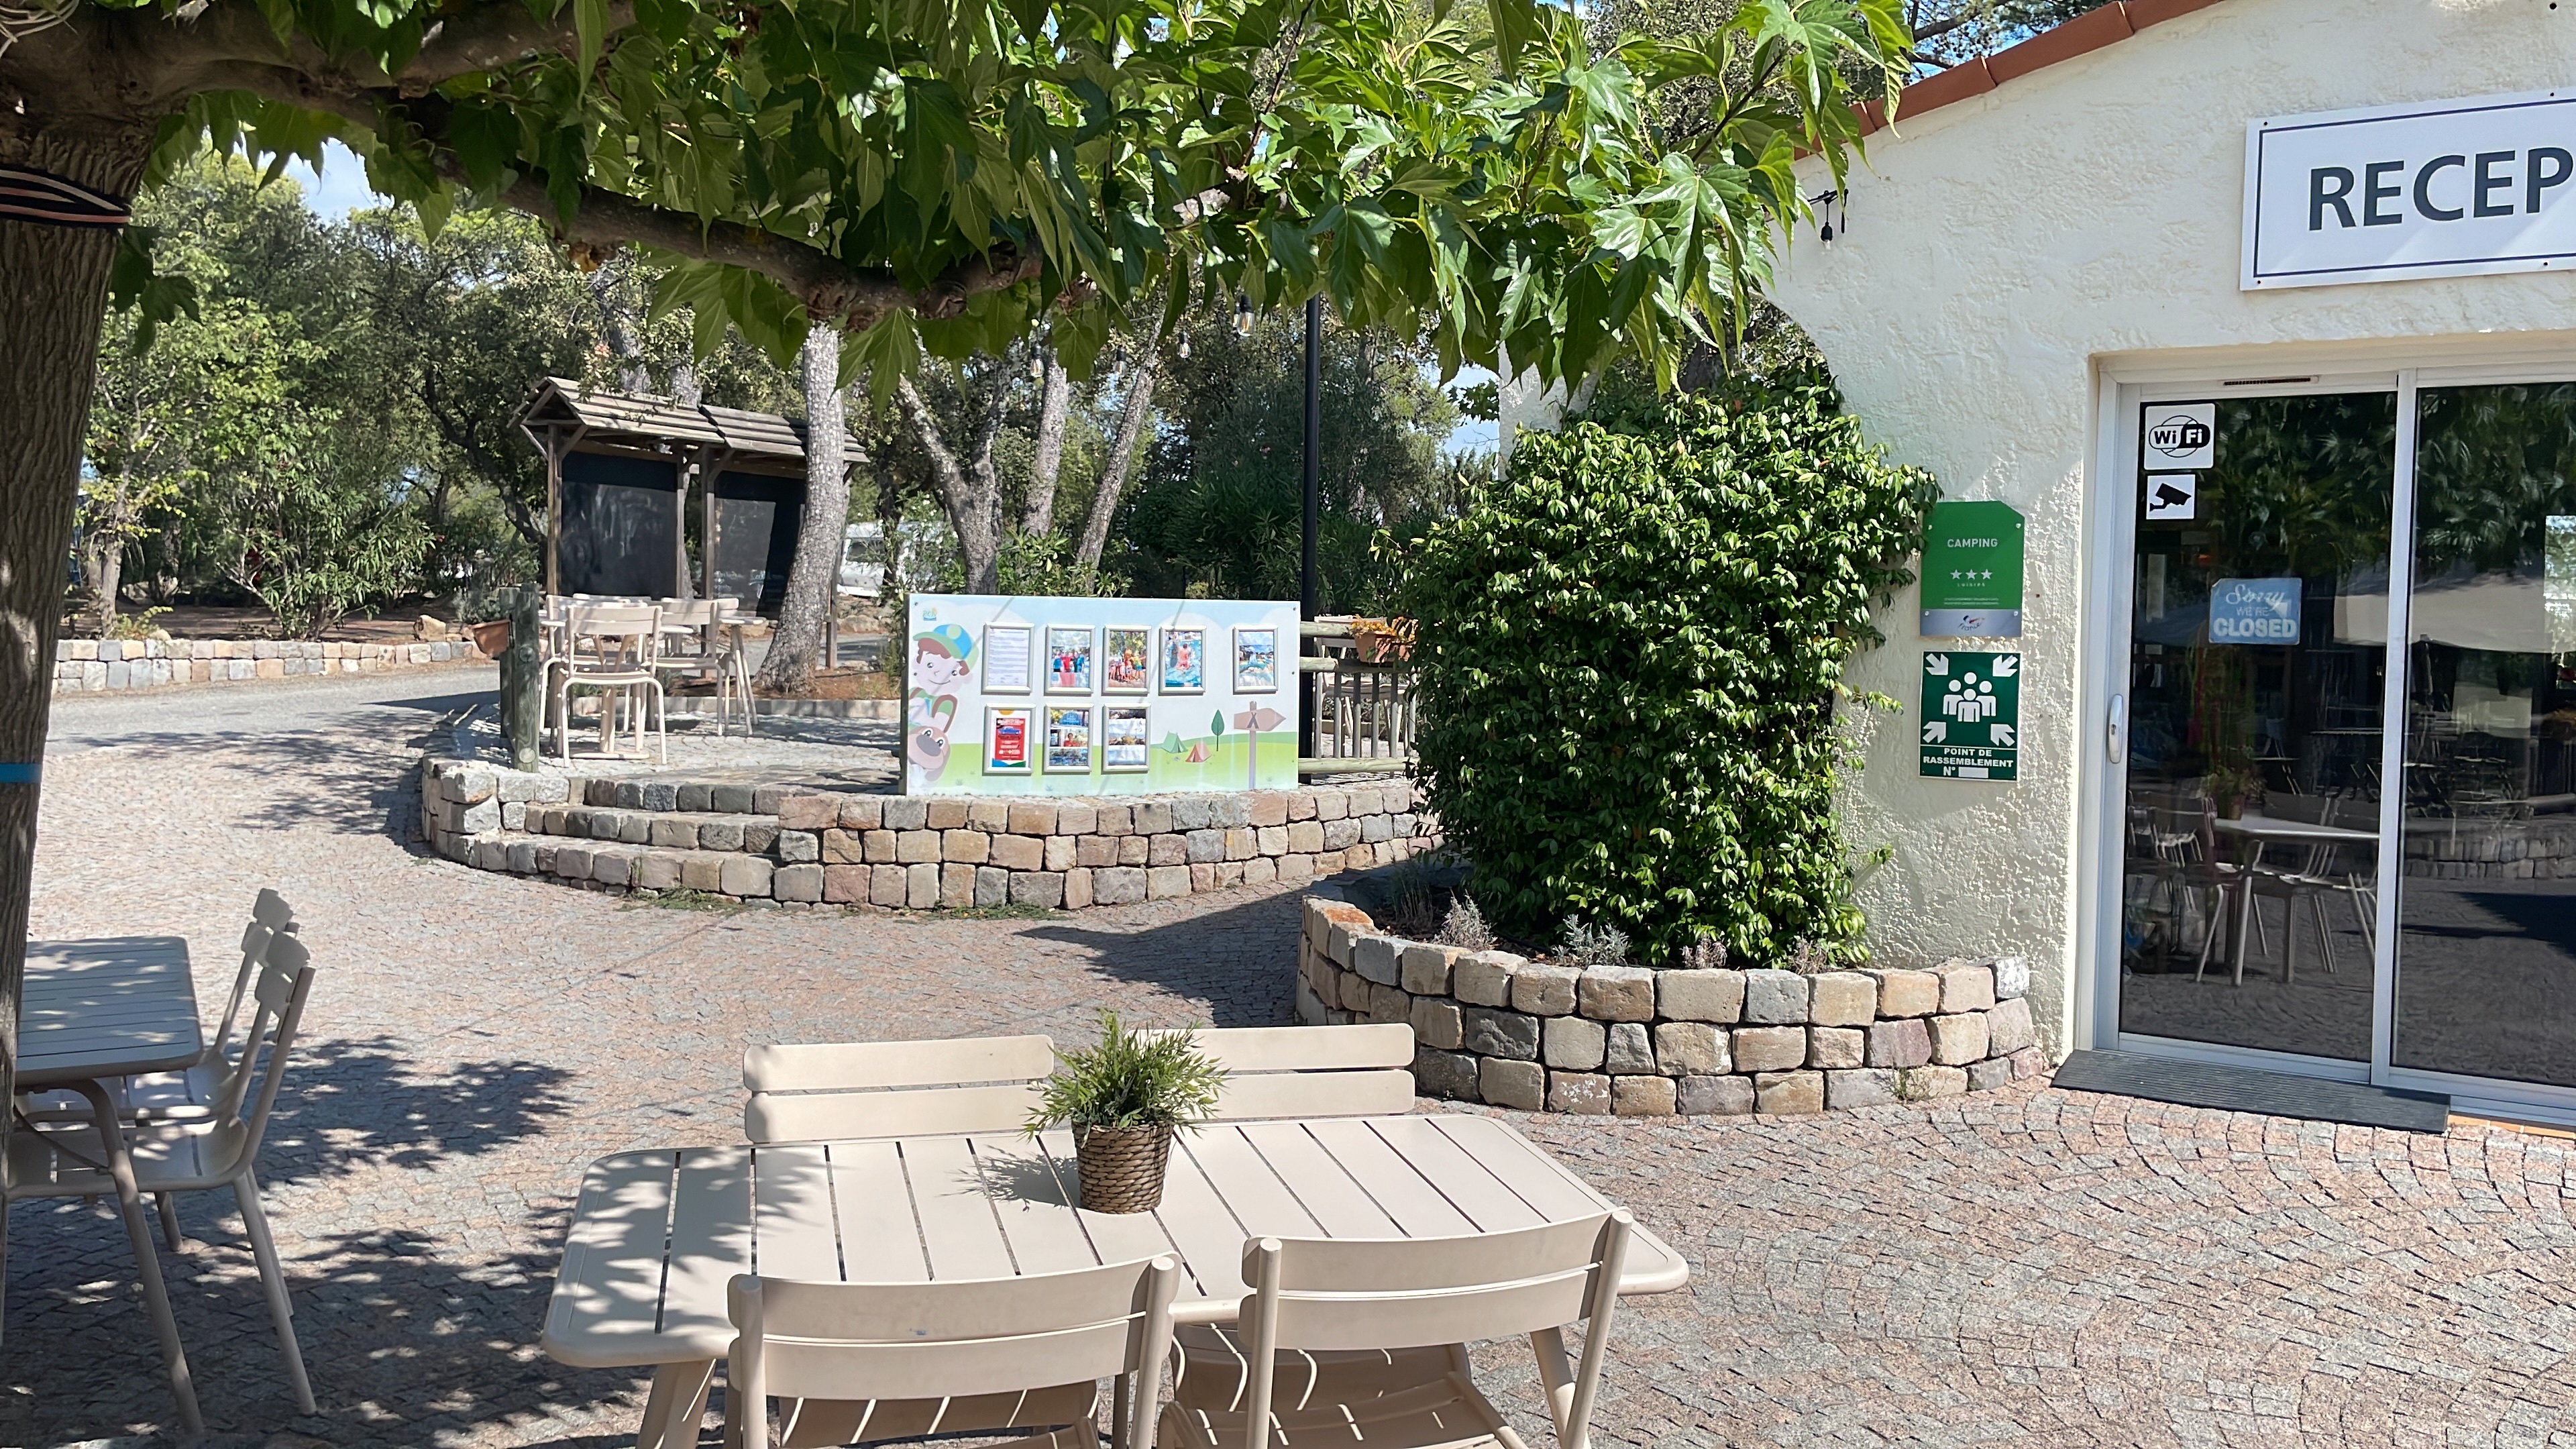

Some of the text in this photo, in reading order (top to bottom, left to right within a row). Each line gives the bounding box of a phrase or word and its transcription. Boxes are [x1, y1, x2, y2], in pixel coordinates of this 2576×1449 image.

[2309, 147, 2574, 231] RECEP
[1947, 538, 1998, 548] CAMPING
[2226, 584, 2285, 611] Sorry
[2237, 606, 2269, 616] WE'RE
[2213, 618, 2297, 638] CLOSED
[1944, 748, 1976, 756] POINT
[1923, 757, 2013, 767] RASSEMBLEMENT
[1943, 766, 1955, 776] N°
